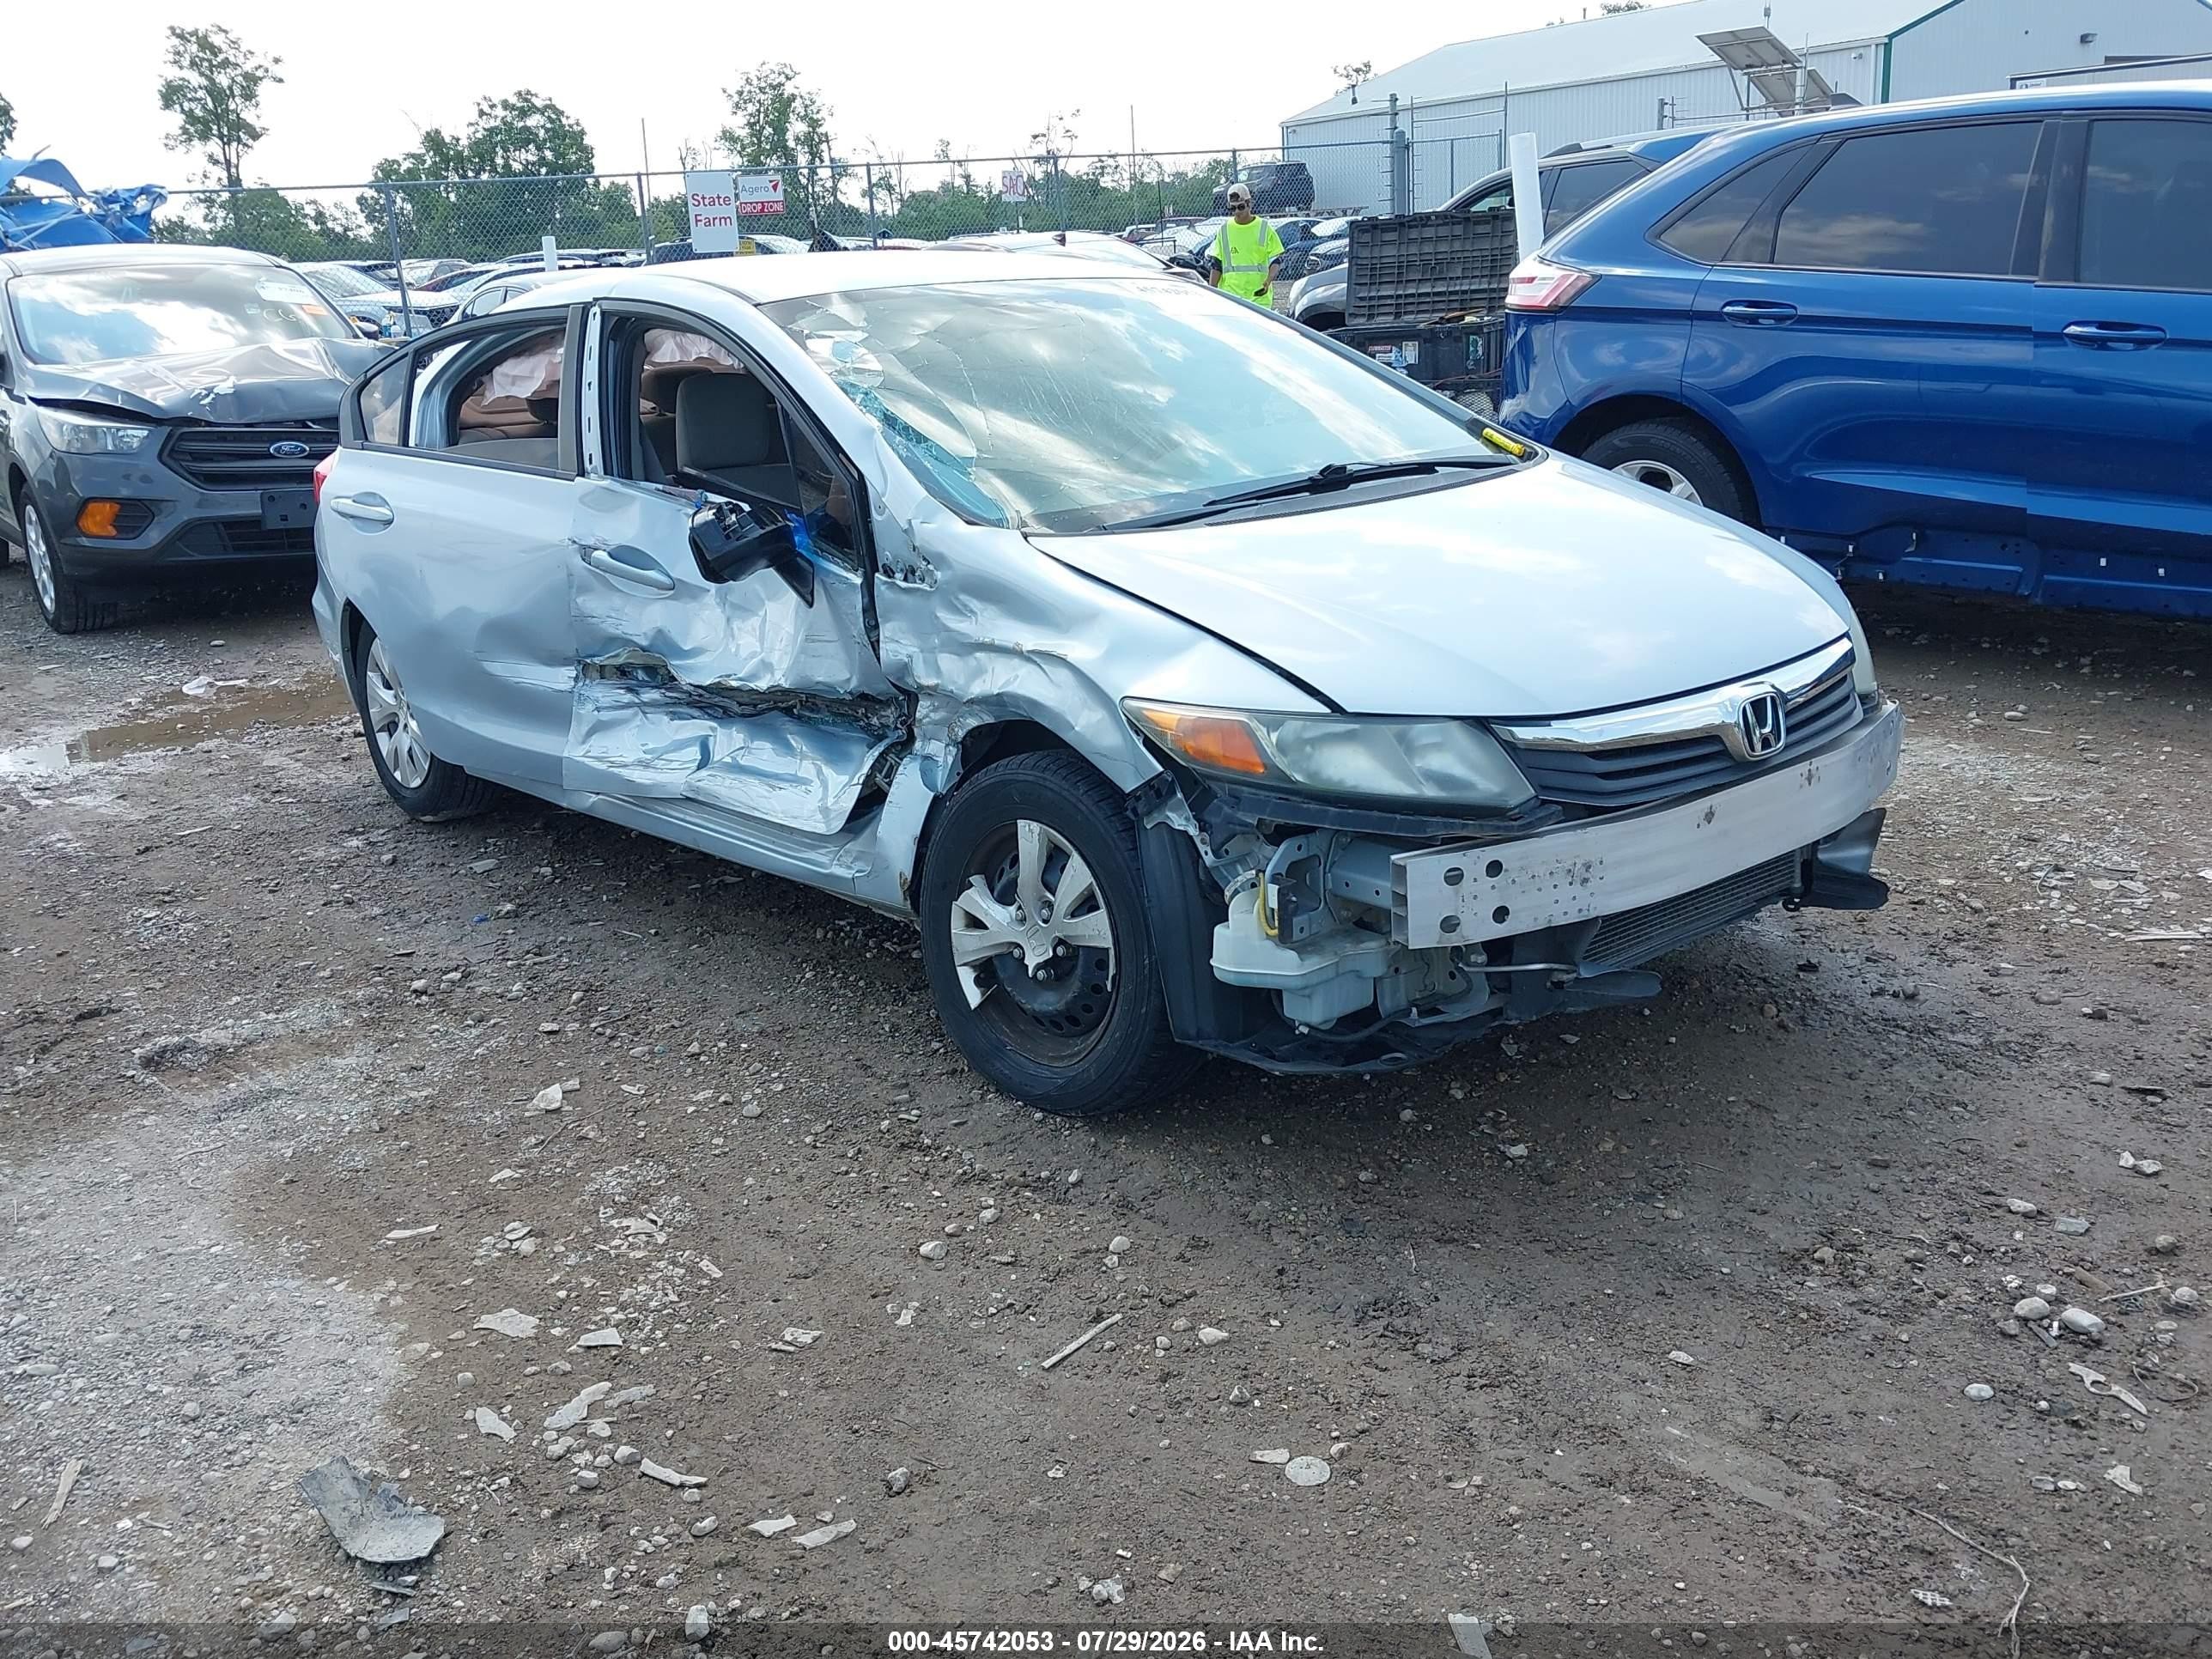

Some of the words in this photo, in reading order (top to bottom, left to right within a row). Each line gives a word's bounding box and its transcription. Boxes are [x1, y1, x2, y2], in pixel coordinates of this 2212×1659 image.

[740, 184, 769, 196] Agero
[691, 193, 732, 207] State
[741, 203, 762, 213] DROP
[763, 202, 784, 212] ZONE
[694, 213, 732, 228] Farm
